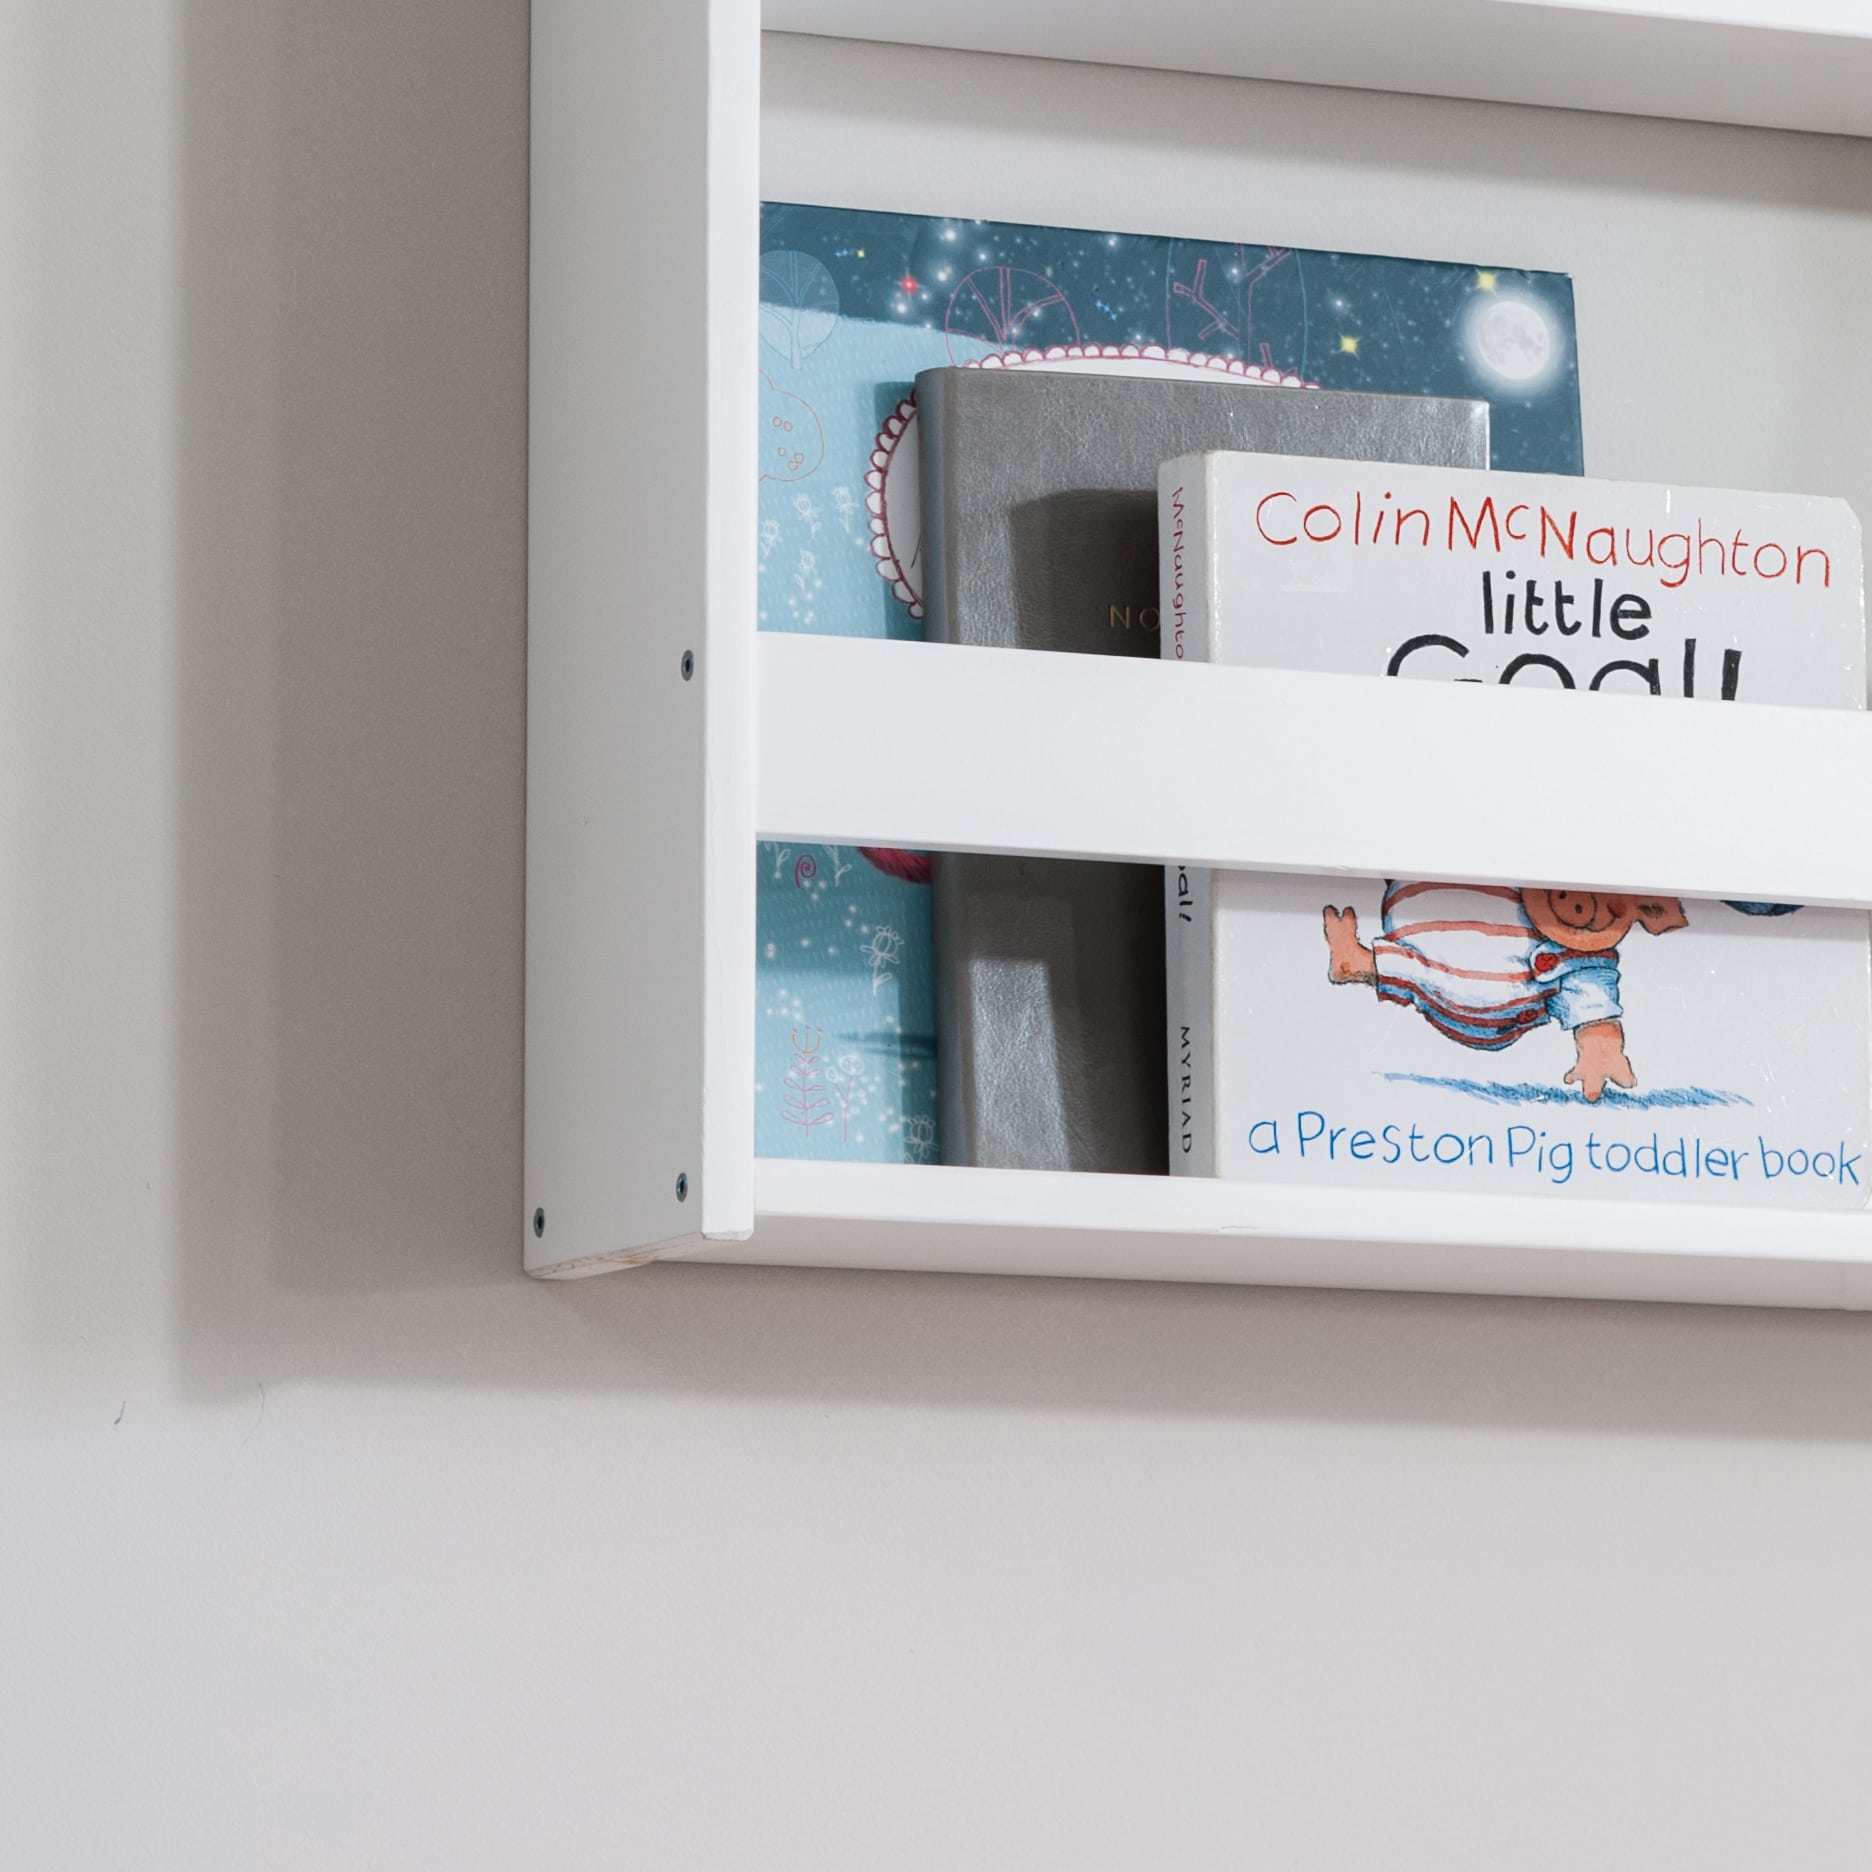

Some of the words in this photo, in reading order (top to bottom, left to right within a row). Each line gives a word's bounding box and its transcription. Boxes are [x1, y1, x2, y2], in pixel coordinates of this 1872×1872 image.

[1254, 490, 1430, 548] Colin
[1446, 494, 1833, 589] McNaughton
[1480, 570, 1653, 641] little
[1179, 1025, 1193, 1155] MYRIAD
[1247, 1110, 1281, 1156] a
[1296, 1109, 1493, 1166] Preston
[1506, 1124, 1574, 1185] Pig
[1584, 1130, 1750, 1182] toddler
[1758, 1135, 1863, 1187] book
